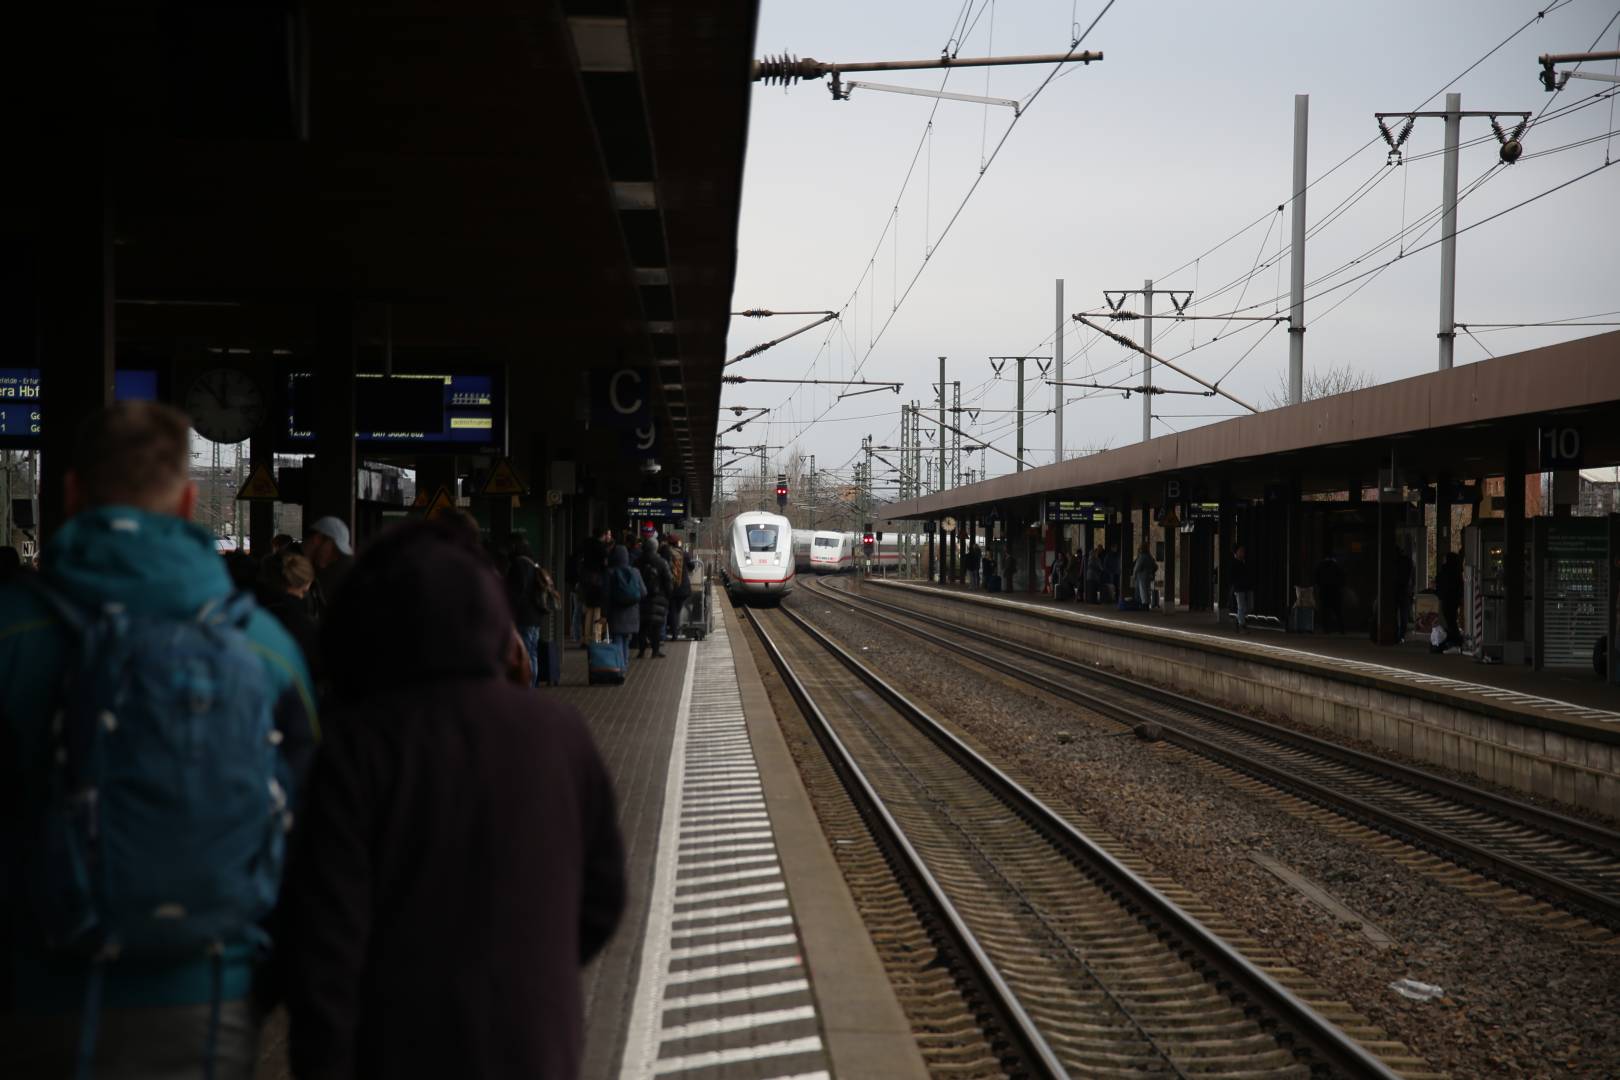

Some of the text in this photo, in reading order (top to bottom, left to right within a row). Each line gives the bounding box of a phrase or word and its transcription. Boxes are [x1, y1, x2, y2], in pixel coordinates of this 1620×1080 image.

[19, 385, 40, 397] Hbf
[609, 369, 642, 414] C
[636, 422, 656, 449] 9
[1543, 427, 1580, 459] 10
[669, 478, 682, 494] B
[1167, 481, 1181, 498] B
